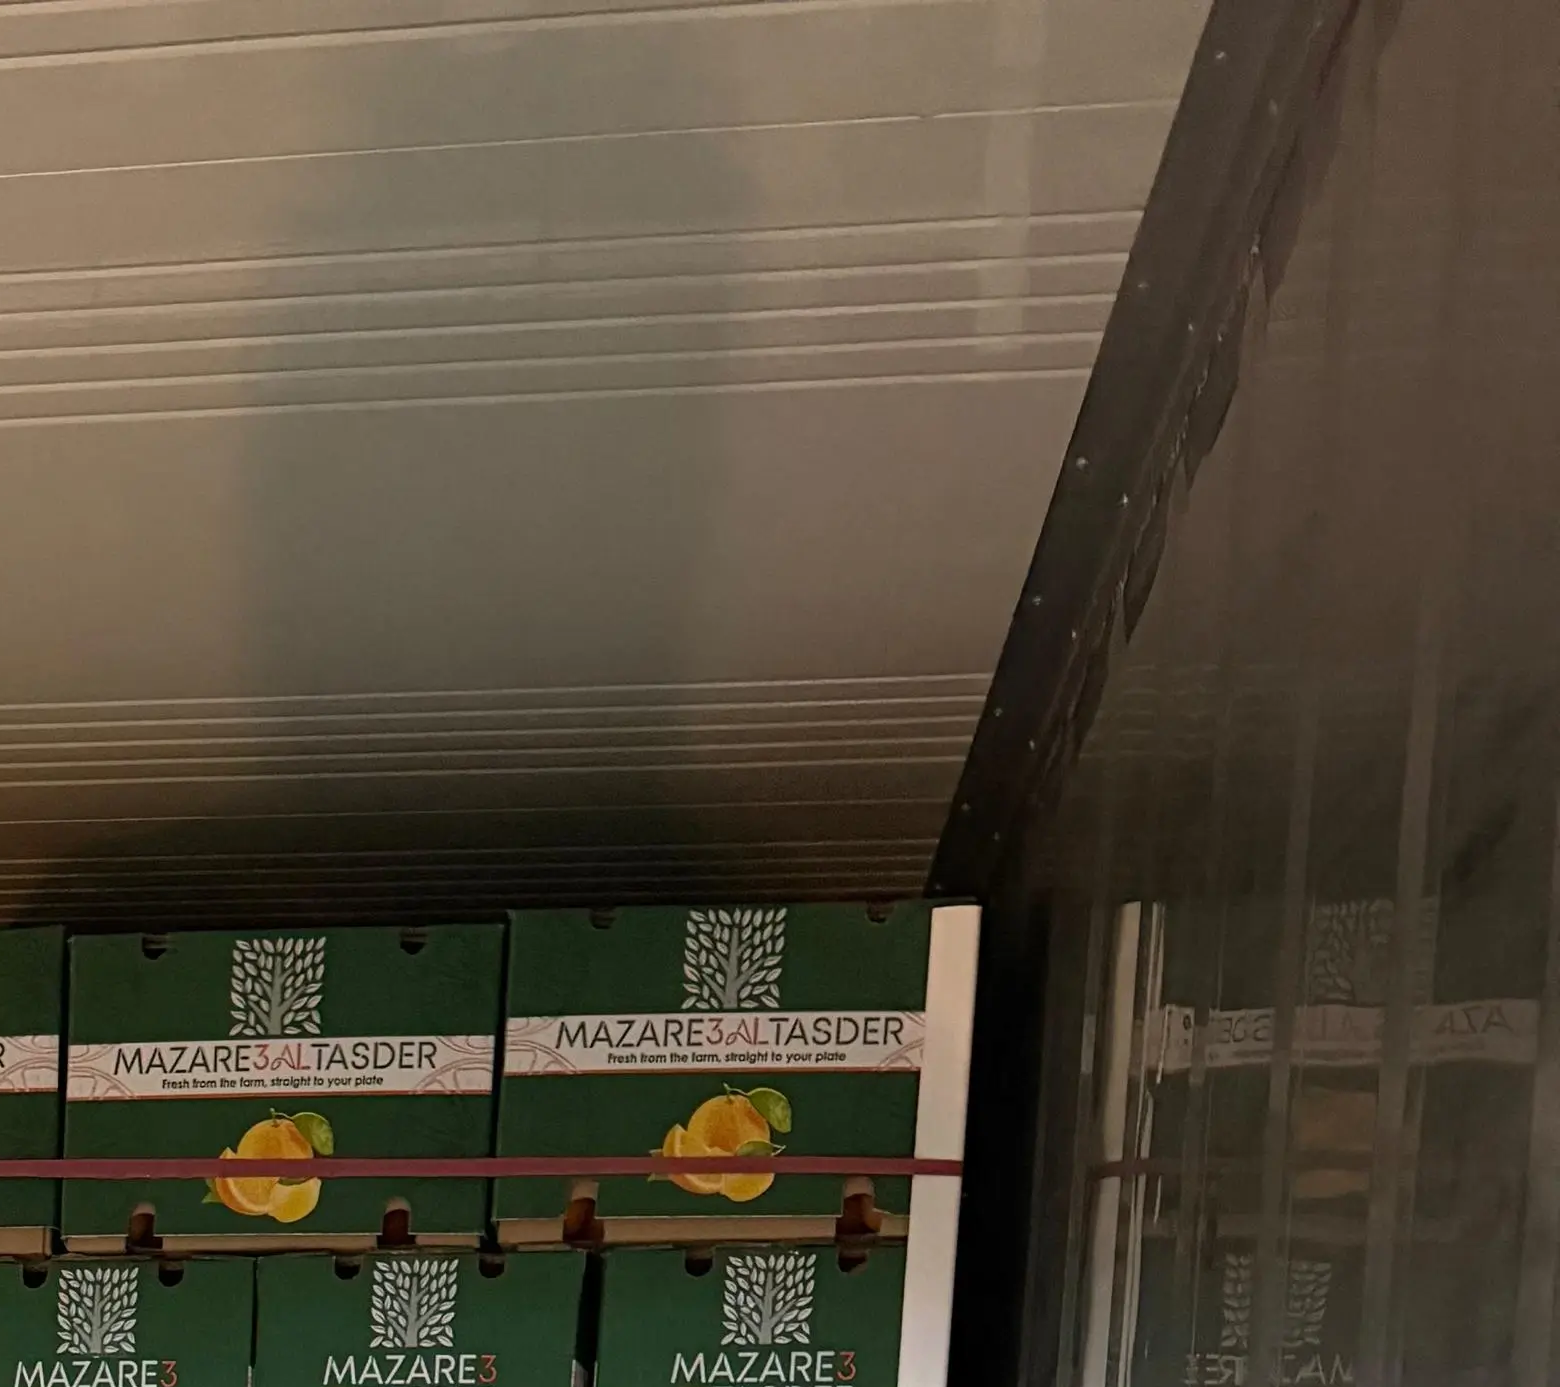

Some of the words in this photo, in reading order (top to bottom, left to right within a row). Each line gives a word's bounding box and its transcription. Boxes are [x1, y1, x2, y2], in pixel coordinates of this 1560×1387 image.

[555, 1016, 904, 1050] MAZARE3ALTASDER
[113, 1041, 437, 1075] MAZARE3ALTASDER
[608, 1053, 637, 1063] Fresh
[640, 1053, 666, 1063] from
[670, 1052, 687, 1062] the
[691, 1052, 721, 1063] farm,
[724, 1052, 767, 1064] straight
[770, 1052, 782, 1061] to
[785, 1054, 811, 1064] your
[814, 1051, 846, 1063] plate
[162, 1079, 189, 1088] Fresh
[192, 1078, 216, 1088] from
[220, 1078, 236, 1088] the
[239, 1078, 268, 1088] farm,
[270, 1077, 310, 1089] straight
[313, 1078, 324, 1086] to
[327, 1079, 351, 1089] your
[354, 1076, 383, 1088] plate
[323, 1355, 497, 1385] MAZARE3
[671, 1351, 856, 1383] MAZARE3
